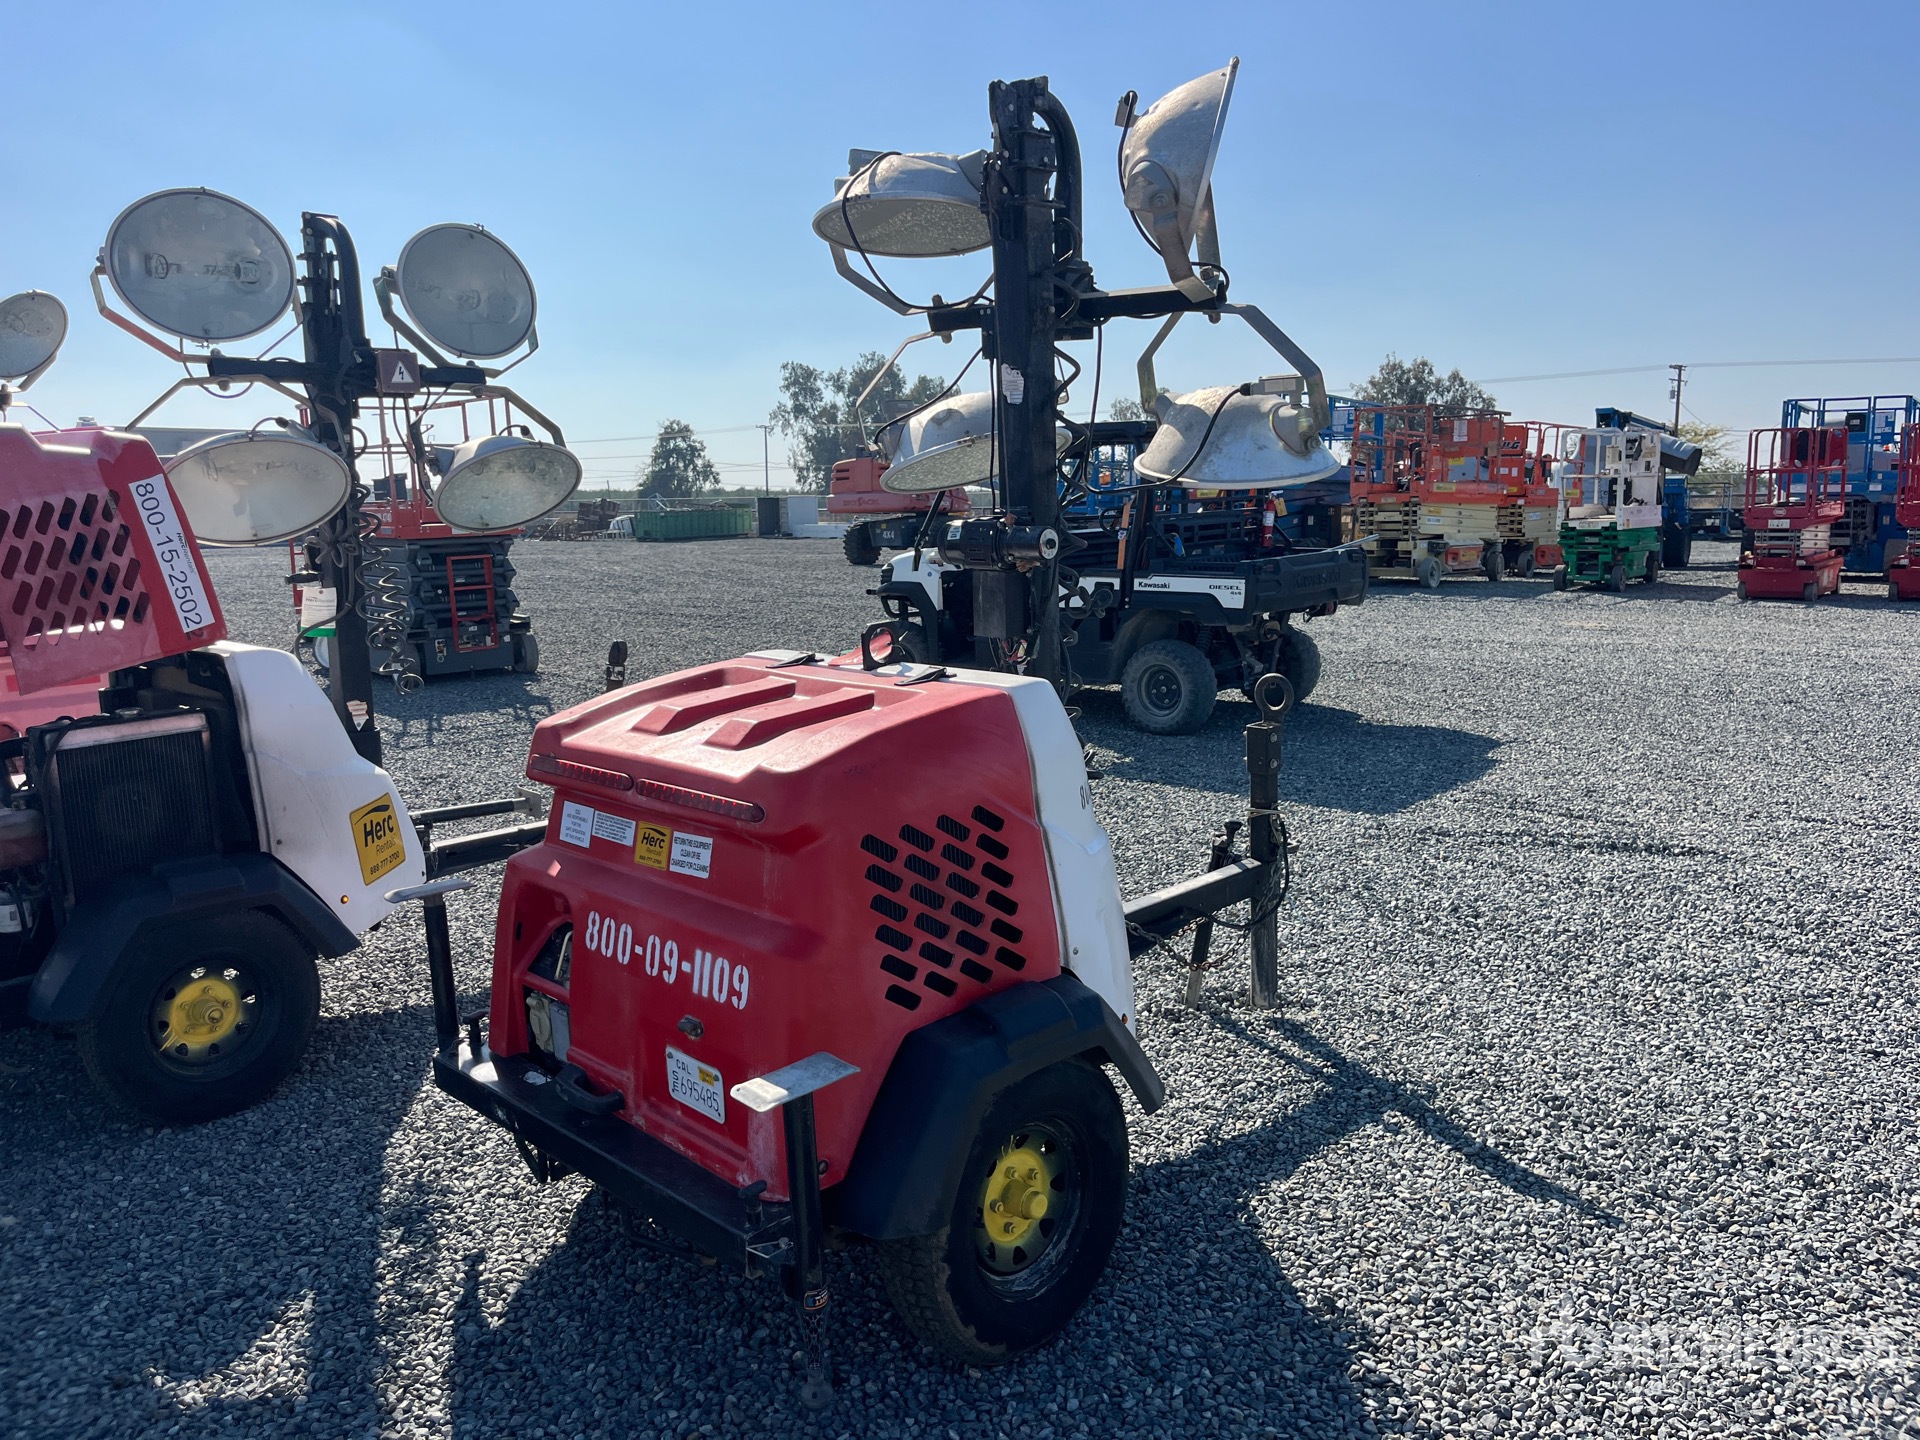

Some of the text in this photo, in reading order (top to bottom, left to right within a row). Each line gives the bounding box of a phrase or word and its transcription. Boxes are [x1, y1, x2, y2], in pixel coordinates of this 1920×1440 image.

[135, 482, 203, 629] 800-15-2502
[1138, 581, 1170, 590] Kawasaki
[364, 814, 394, 848] Herc
[641, 831, 665, 849] Herc
[376, 838, 396, 855] Rentals
[585, 910, 750, 1010] 800-09-1109
[676, 1059, 692, 1075] CAL
[681, 1076, 720, 1112] 695485
